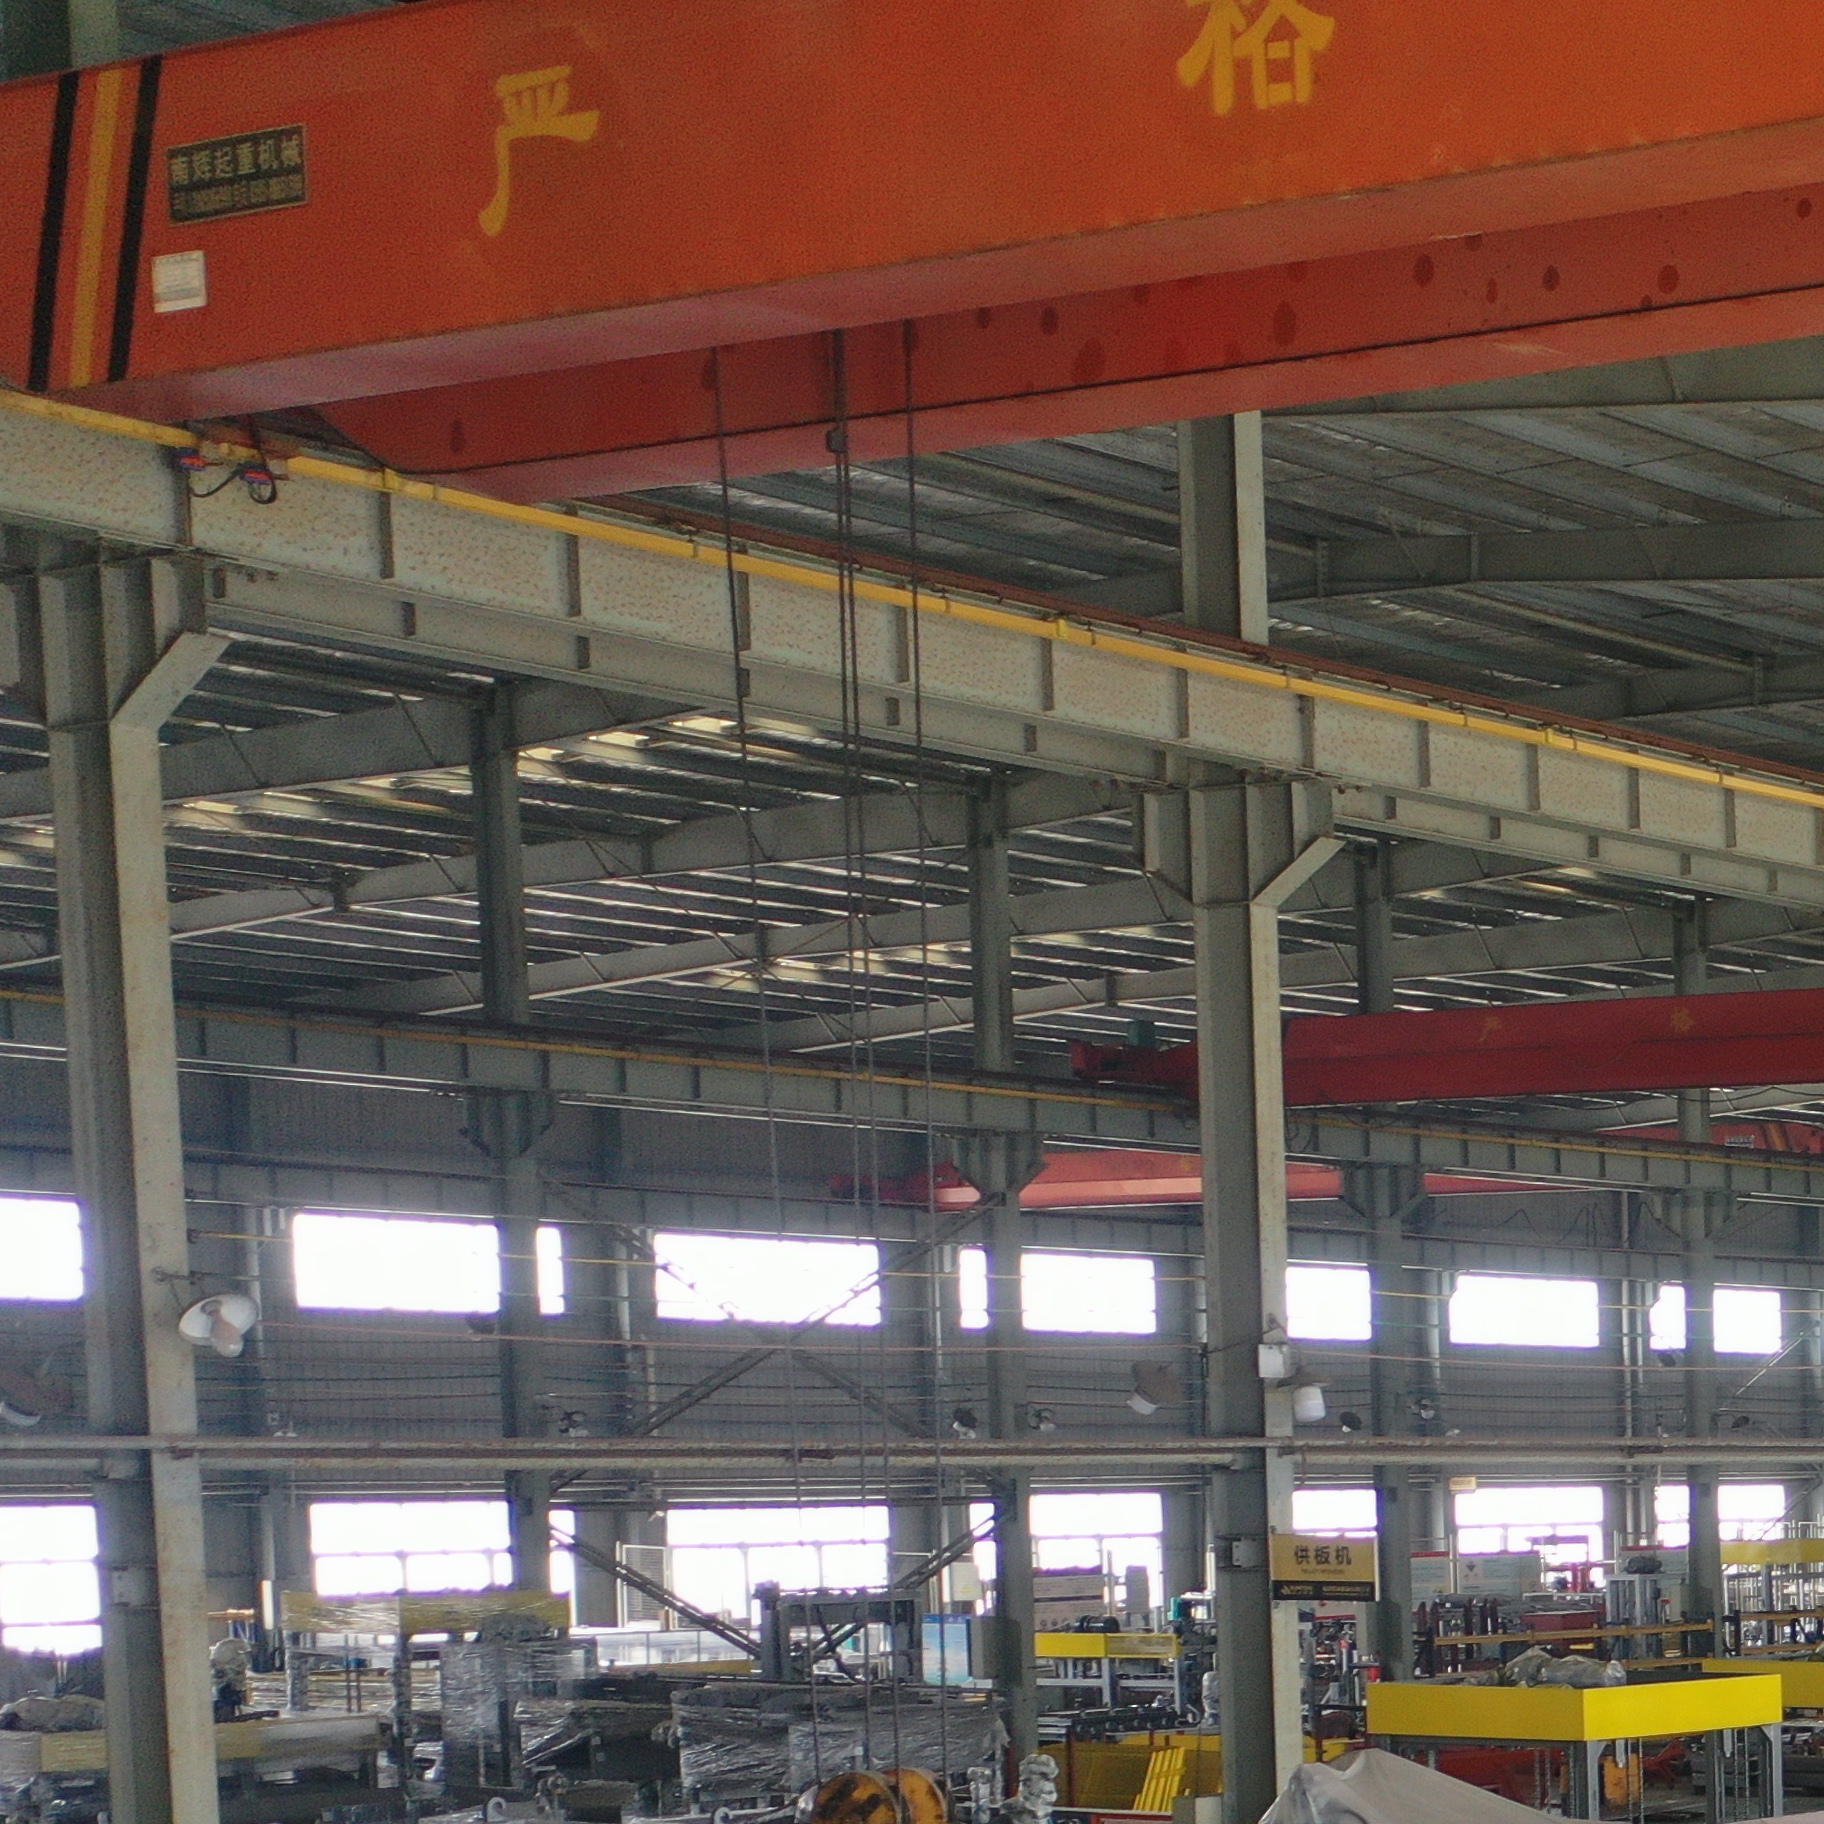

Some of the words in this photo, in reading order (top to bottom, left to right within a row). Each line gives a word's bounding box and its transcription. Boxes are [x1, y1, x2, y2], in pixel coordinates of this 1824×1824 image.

[478, 65, 602, 237] 严
[1293, 1545, 1352, 1565] 供板机
